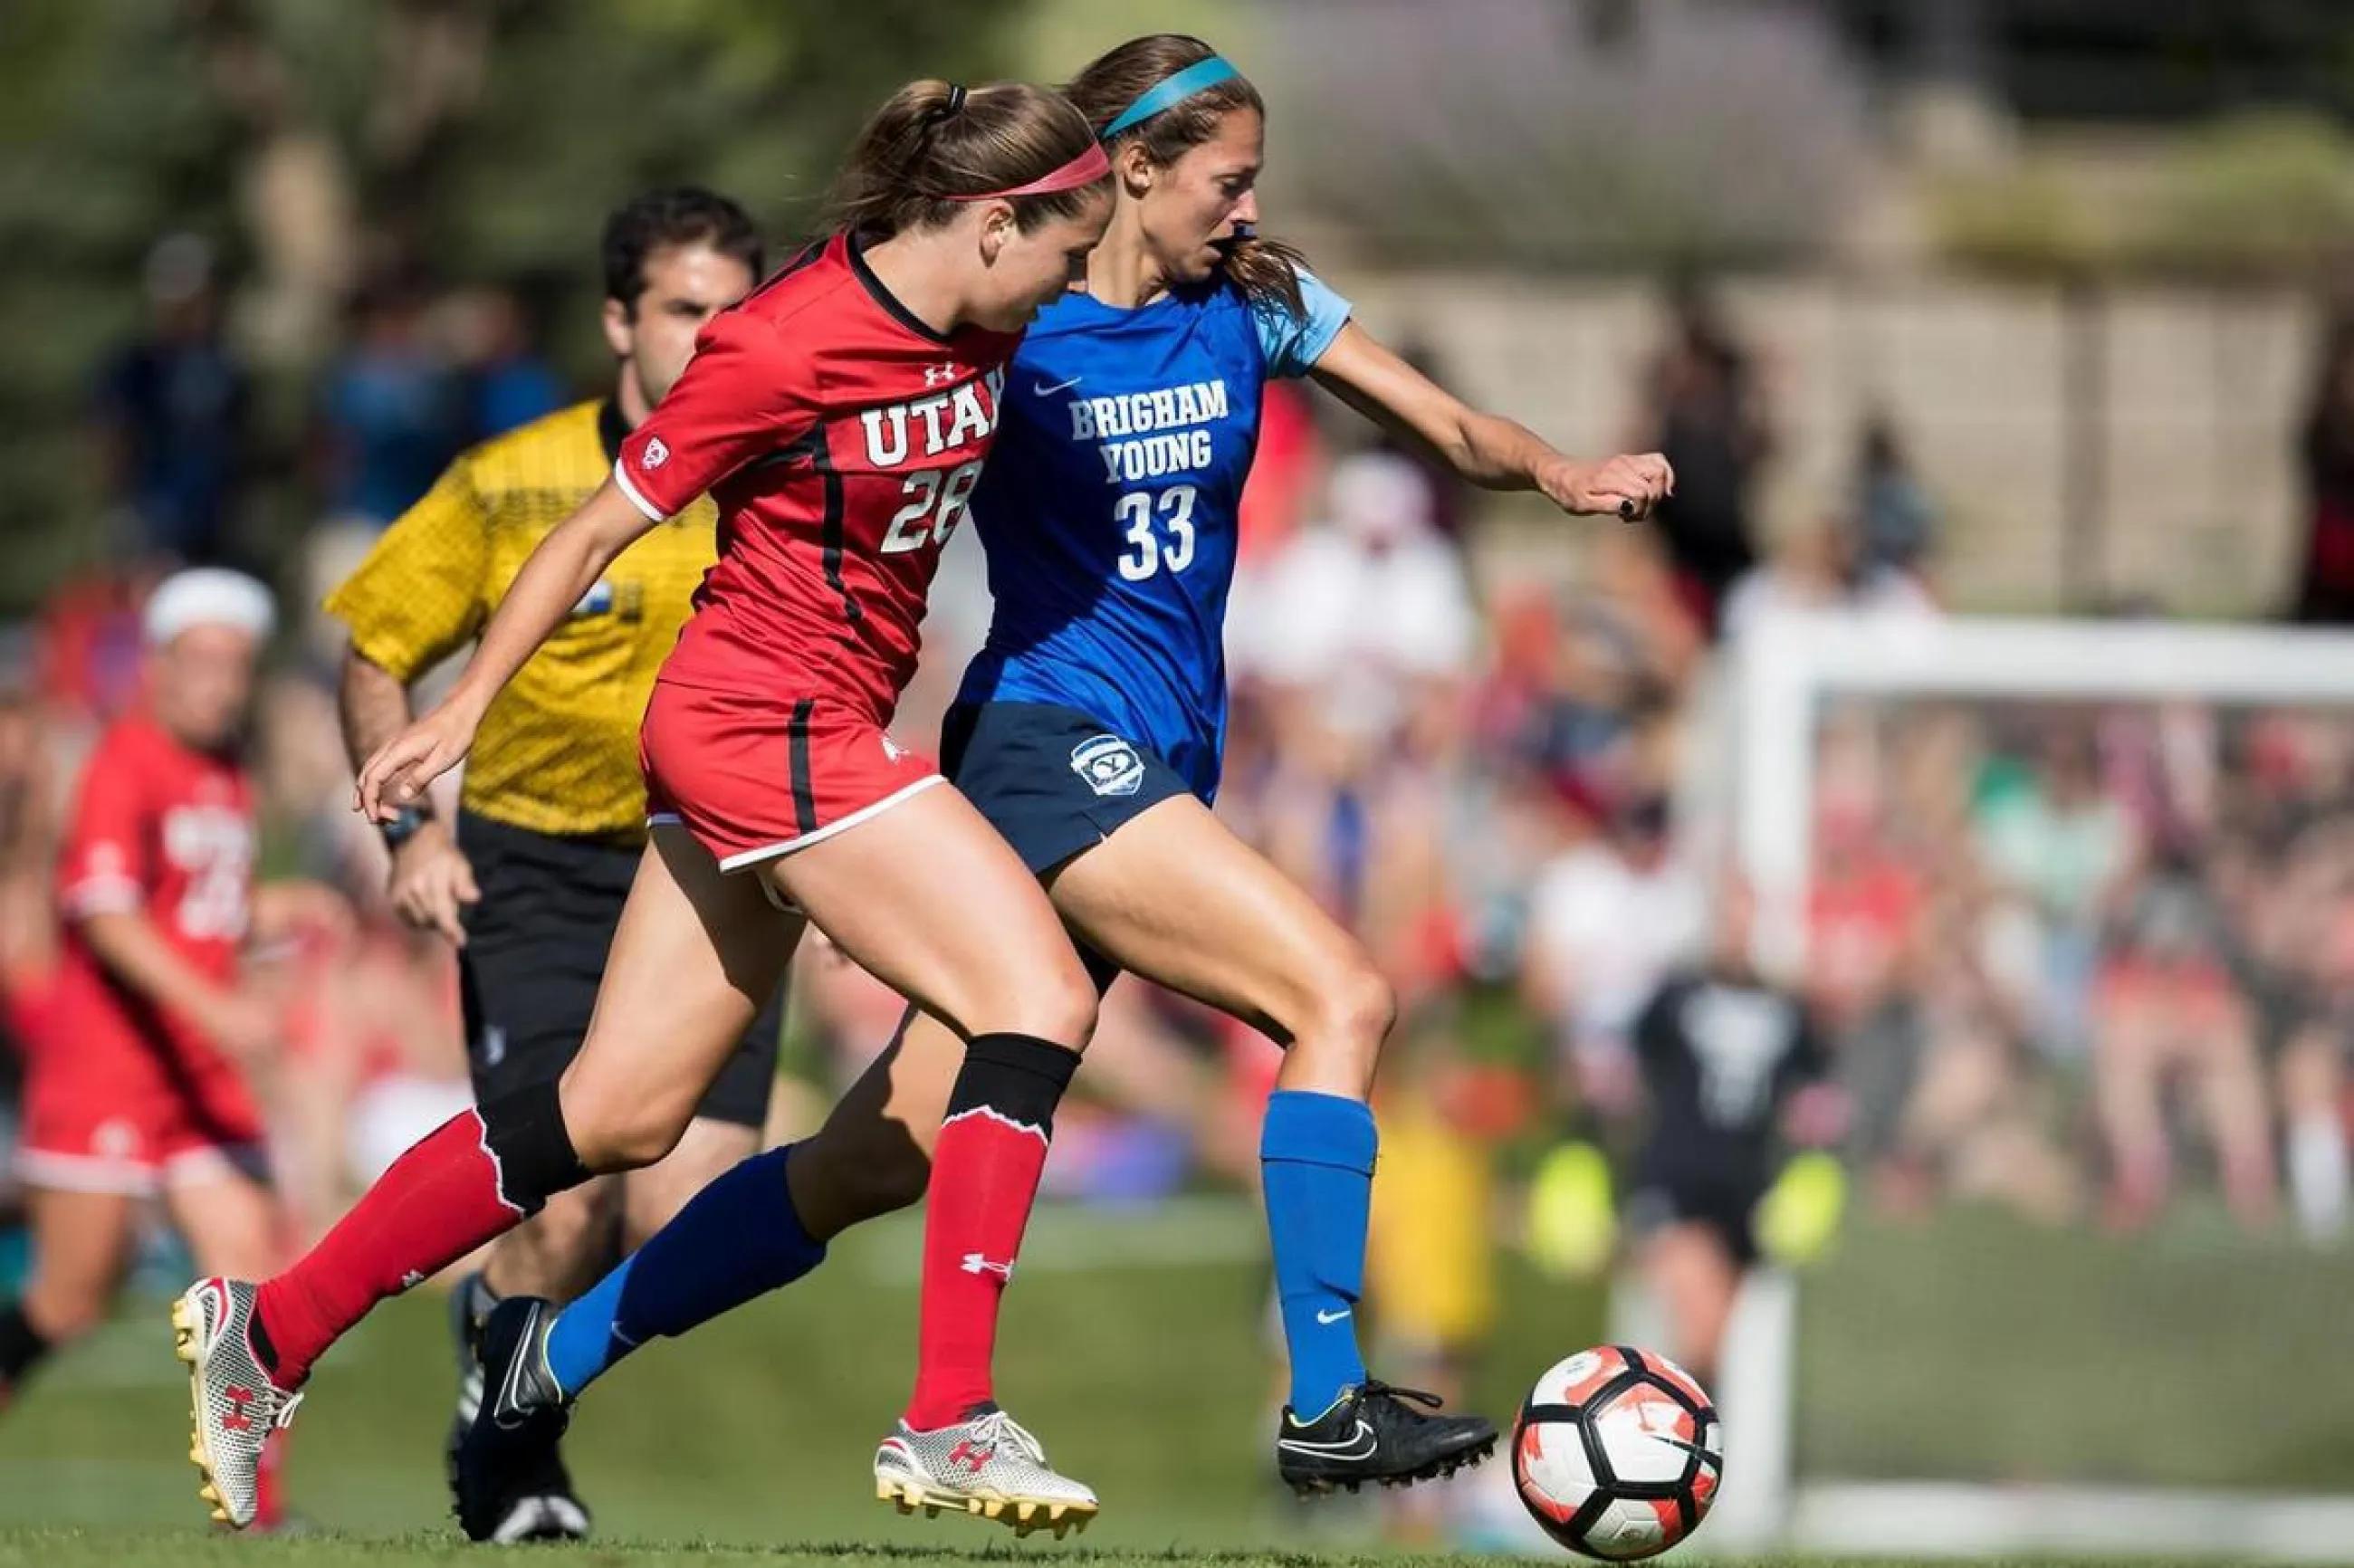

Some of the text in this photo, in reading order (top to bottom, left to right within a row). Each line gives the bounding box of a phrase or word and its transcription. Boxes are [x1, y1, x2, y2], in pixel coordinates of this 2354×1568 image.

[1068, 380, 1229, 440] BRIGHAM
[1100, 430, 1211, 483] YOUNG
[881, 460, 983, 552] 28
[1114, 485, 1196, 581] 33
